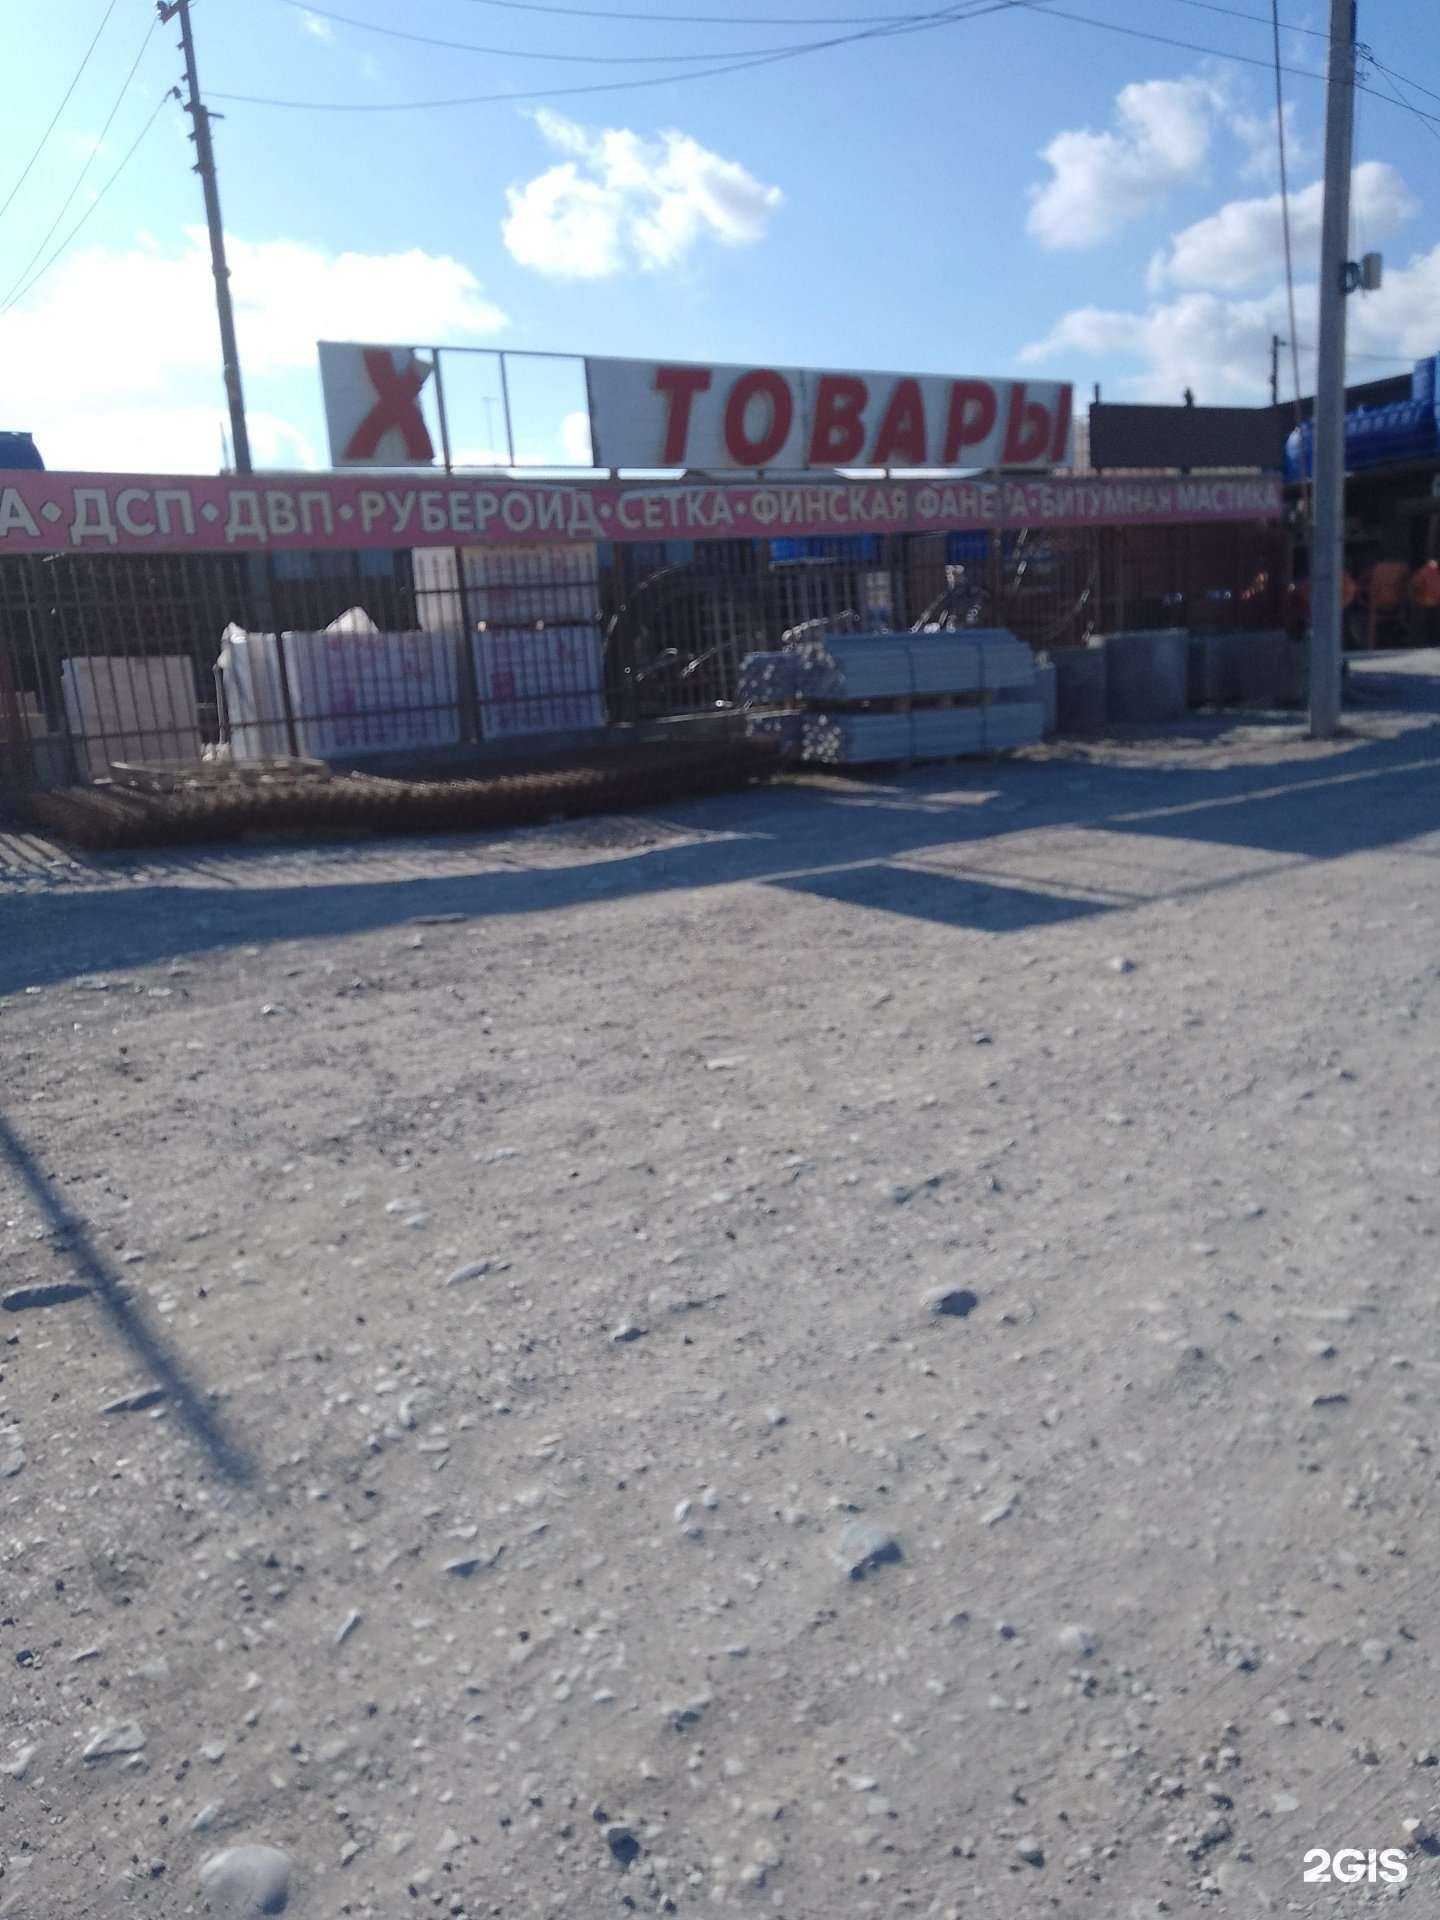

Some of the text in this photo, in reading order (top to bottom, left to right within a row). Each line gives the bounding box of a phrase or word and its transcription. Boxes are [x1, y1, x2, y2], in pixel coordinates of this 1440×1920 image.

[651, 365, 1073, 468] ТОВАРЫ
[71, 487, 193, 545] ДСП
[225, 491, 333, 544] ДВП
[359, 491, 605, 537] РУБЕРОИД
[617, 492, 734, 529] СЕТКА
[750, 487, 911, 524] ФИНСКАЯ
[915, 486, 1028, 520] ФАНЕА
